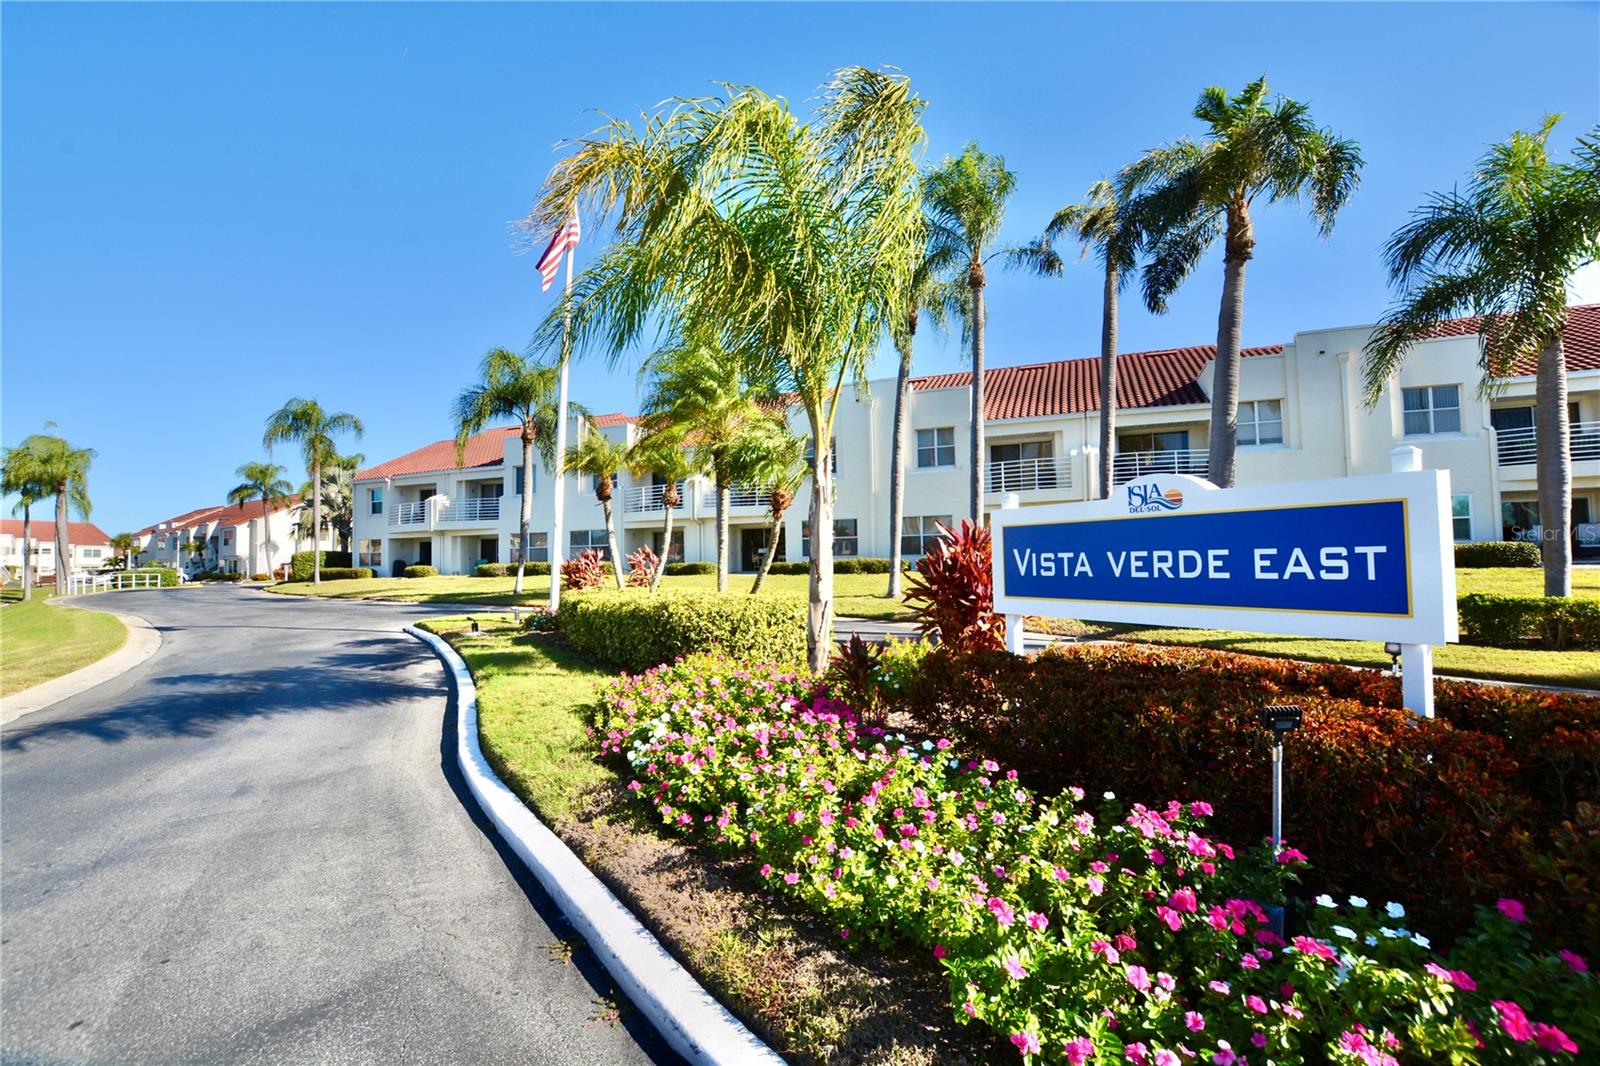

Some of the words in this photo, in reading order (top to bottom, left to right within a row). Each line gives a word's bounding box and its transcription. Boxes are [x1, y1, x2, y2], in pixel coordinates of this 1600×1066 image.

[1013, 548, 1094, 577] VISTA
[1106, 549, 1231, 579] VERDE
[1253, 545, 1388, 581] EAST
